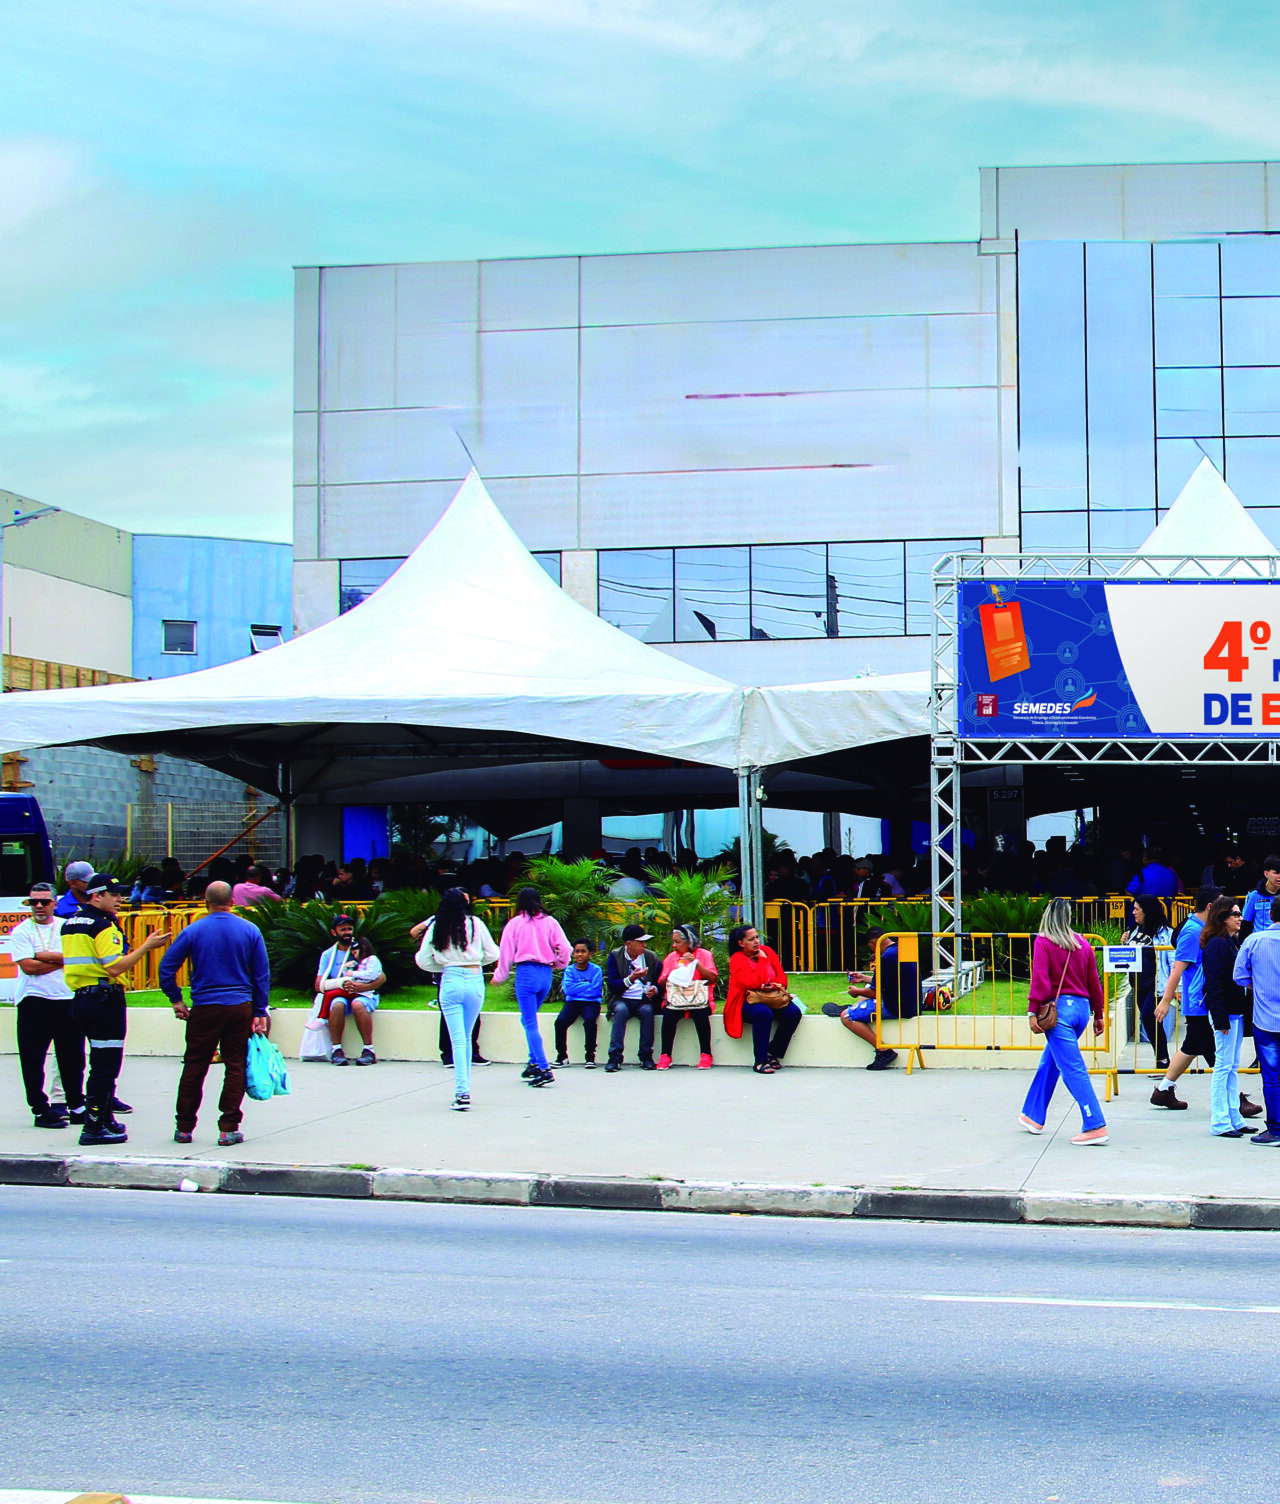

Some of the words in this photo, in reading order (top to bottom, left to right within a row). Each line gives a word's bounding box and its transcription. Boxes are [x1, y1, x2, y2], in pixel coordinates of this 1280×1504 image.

[1203, 620, 1271, 682] 4º
[1013, 703, 1071, 714] SEMEDES
[1203, 692, 1253, 726] DE
[993, 790, 1019, 799] 5.297
